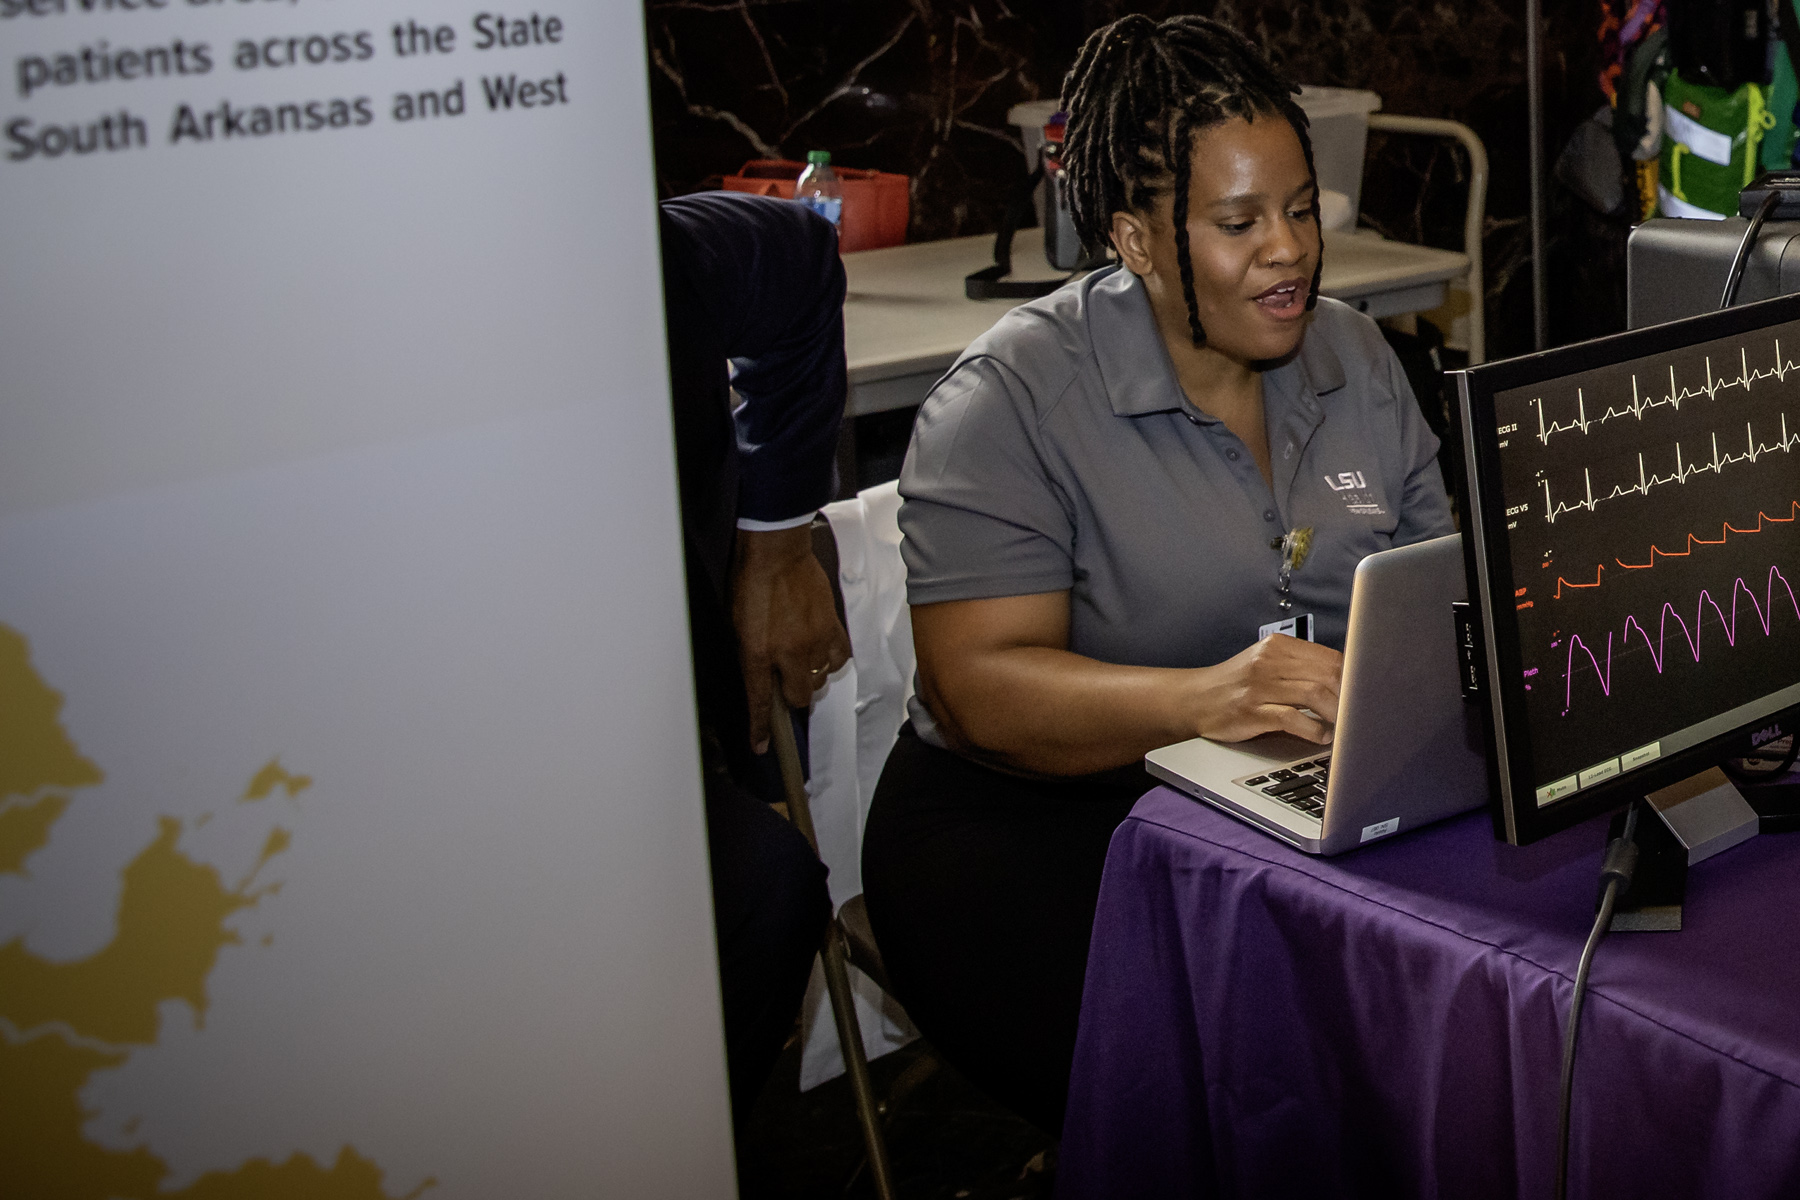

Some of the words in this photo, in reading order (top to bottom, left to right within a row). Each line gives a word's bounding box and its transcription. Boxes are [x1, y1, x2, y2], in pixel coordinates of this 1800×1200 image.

[16, 38, 214, 99] patients
[234, 28, 374, 72] across
[392, 18, 456, 58] the
[473, 11, 564, 50] State
[2, 107, 148, 162] South
[170, 97, 373, 145] Arkansas
[392, 80, 466, 123] and
[481, 71, 569, 112] West
[1498, 425, 1511, 435] ECG
[1499, 440, 1509, 449] mV
[1324, 471, 1367, 491] LSU
[1506, 505, 1520, 516] ECG
[1523, 667, 1539, 679] Pleth
[1751, 723, 1782, 747] DELL
